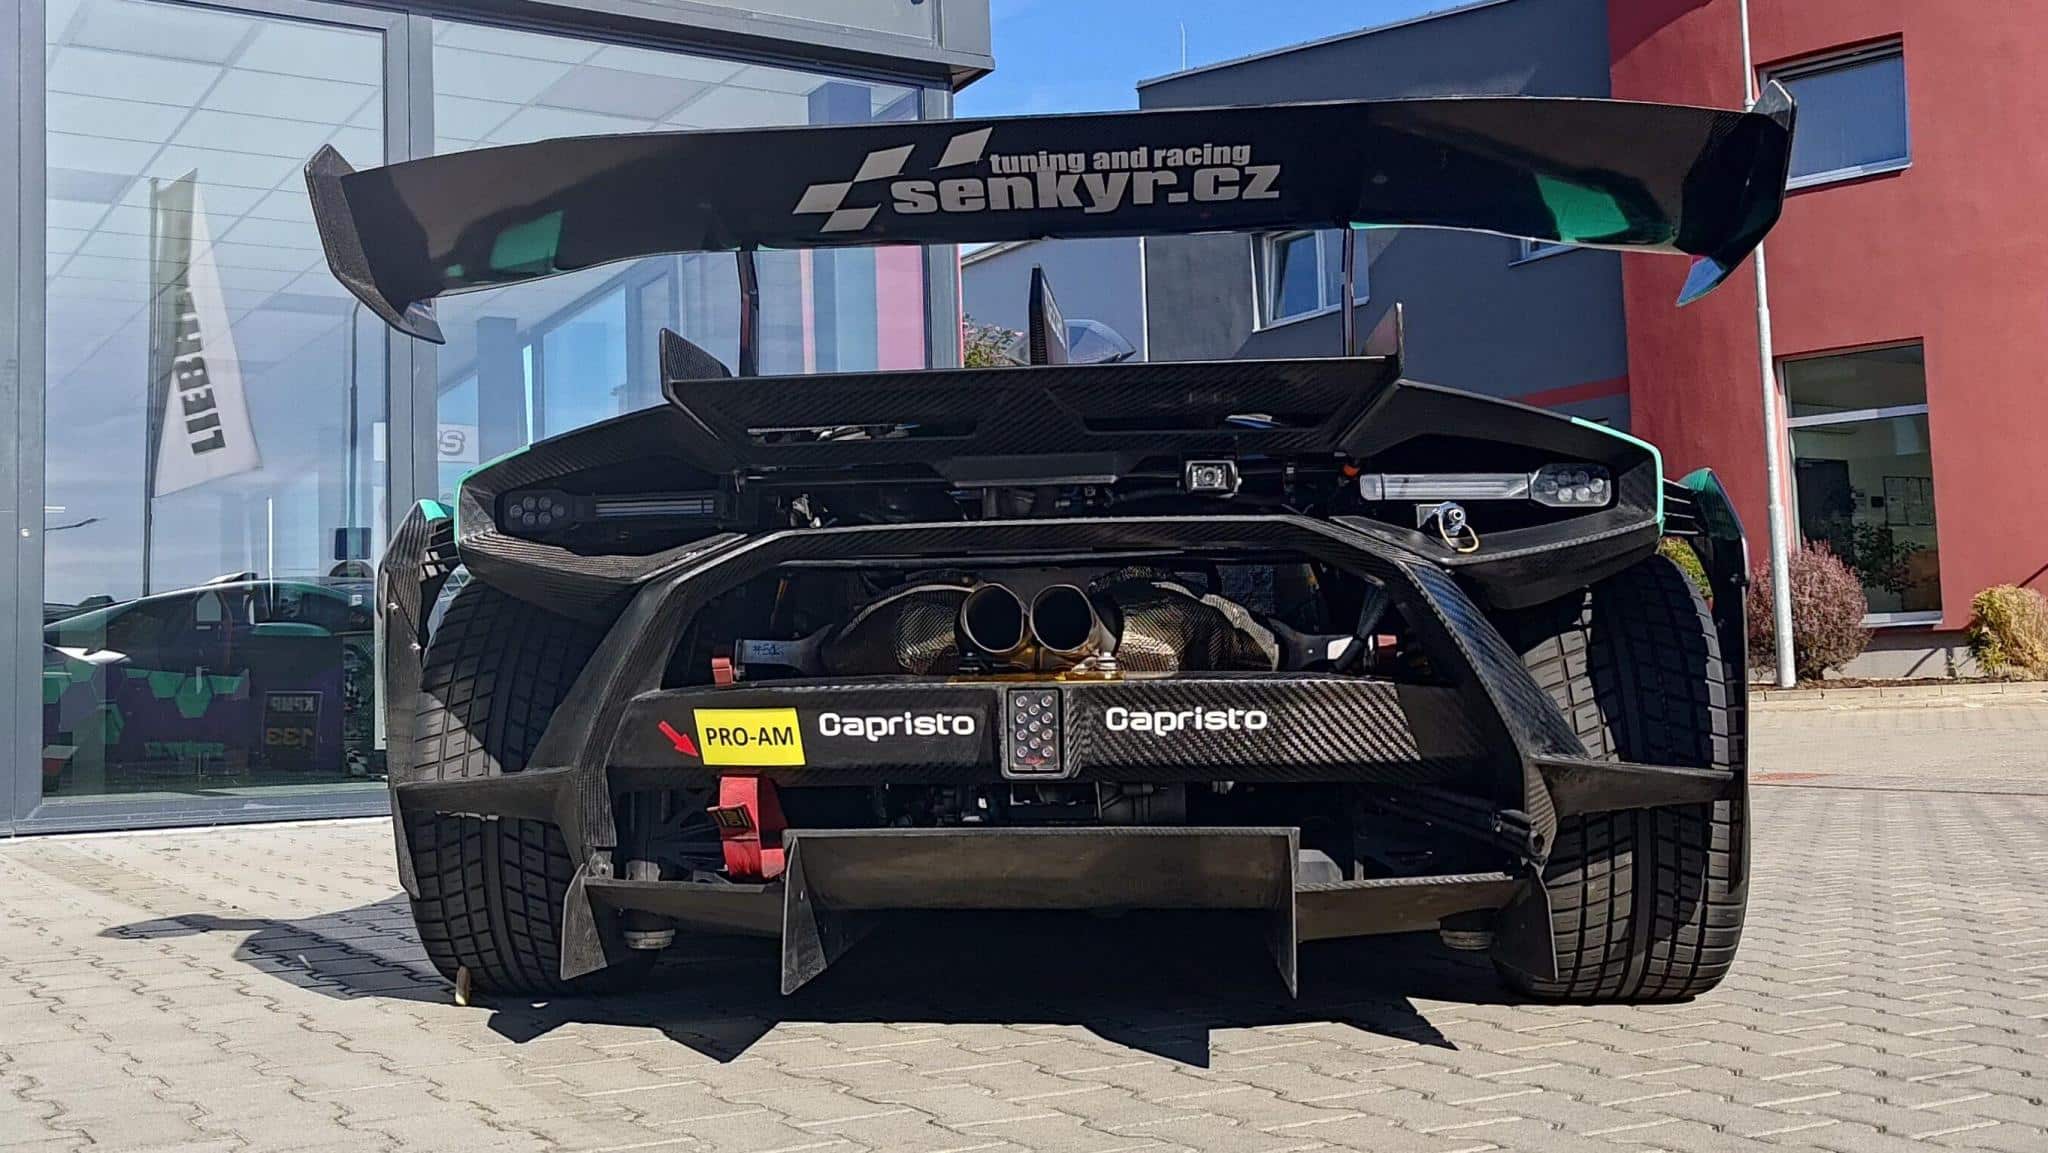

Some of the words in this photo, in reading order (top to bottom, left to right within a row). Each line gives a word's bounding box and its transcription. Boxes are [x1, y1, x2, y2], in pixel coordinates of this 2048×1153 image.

[989, 151, 1085, 174] tuning
[1093, 147, 1148, 170] and
[1153, 144, 1251, 168] racing
[890, 164, 1281, 214] senkyr.cz
[706, 725, 795, 747] PRO-AM
[818, 711, 976, 742] Capristo
[1105, 706, 1268, 737] Capristo
